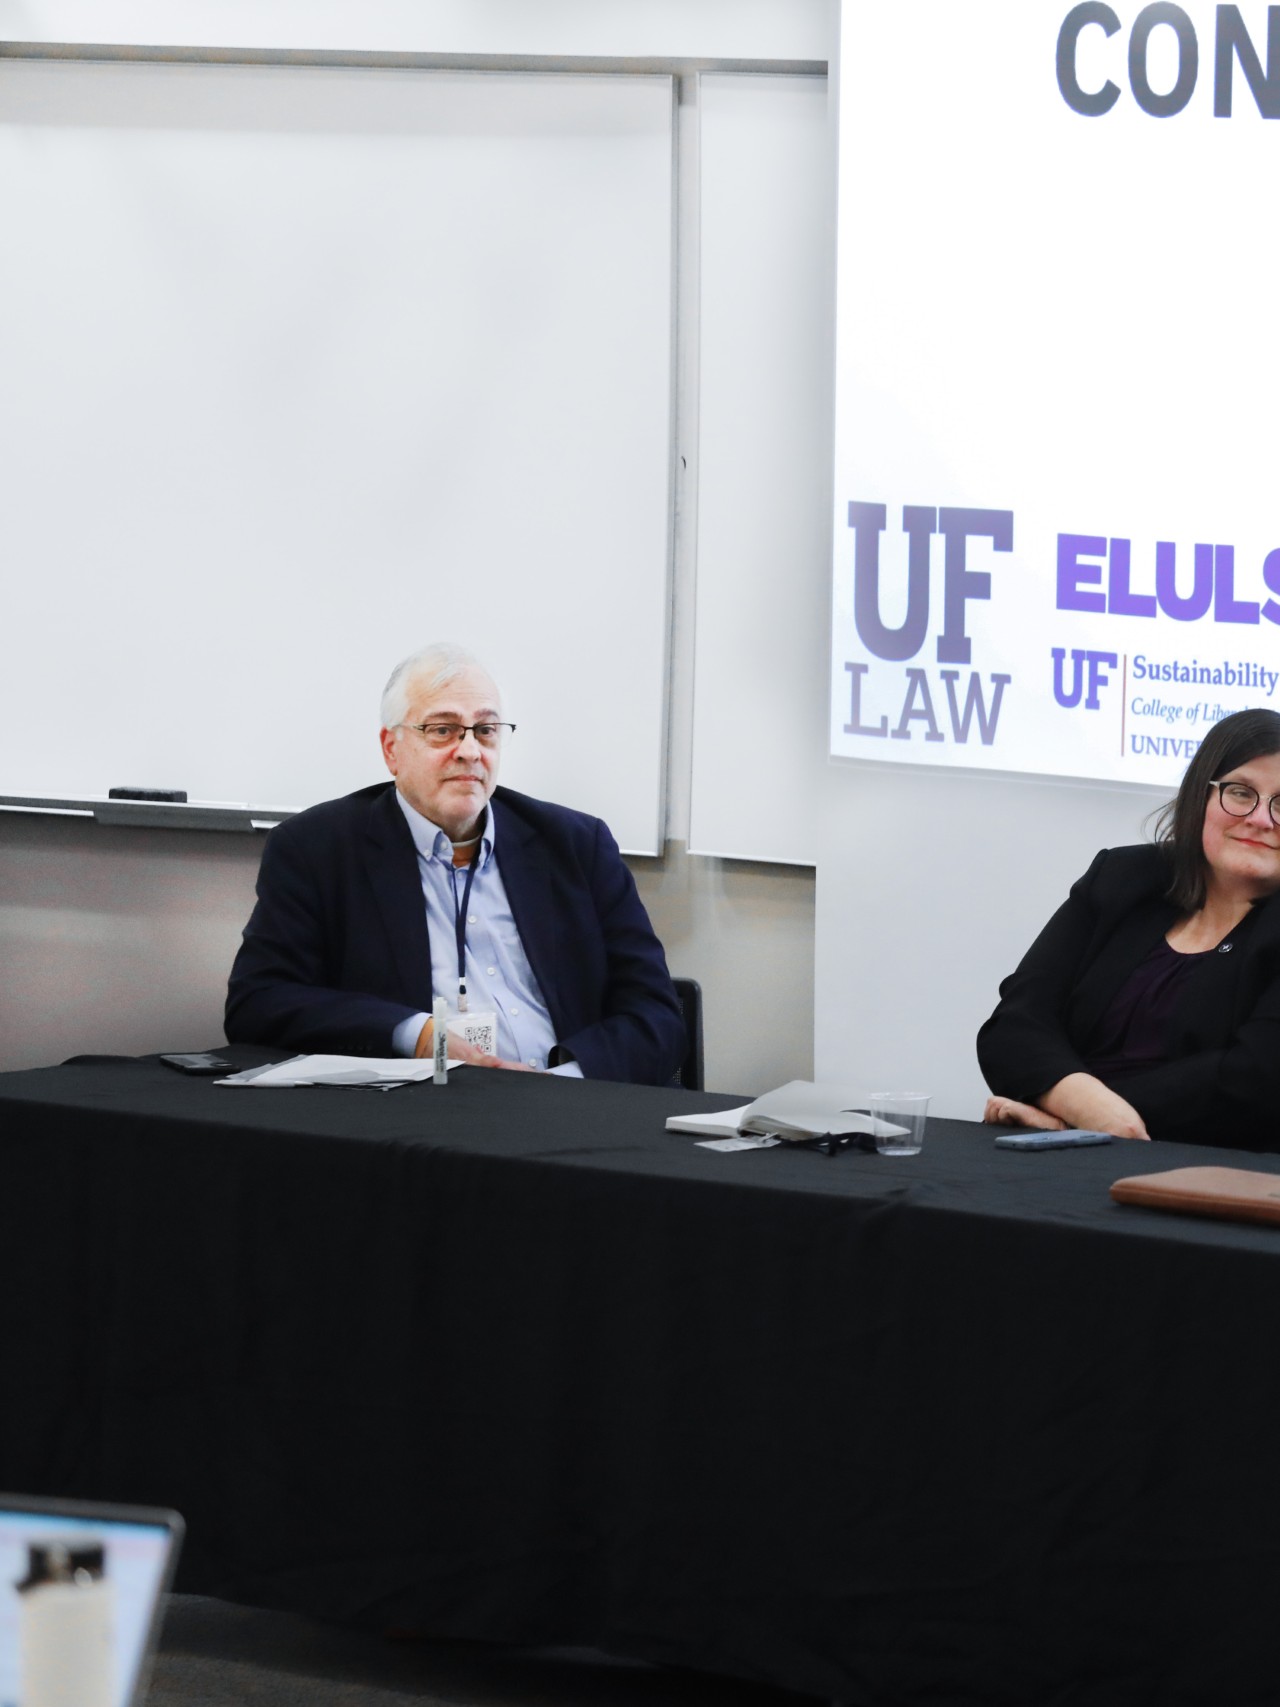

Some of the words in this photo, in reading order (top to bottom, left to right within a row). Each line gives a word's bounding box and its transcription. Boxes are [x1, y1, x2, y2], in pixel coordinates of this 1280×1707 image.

[846, 501, 1014, 664] UF
[843, 661, 1012, 746] LAW
[1051, 647, 1118, 711] UF
[1132, 655, 1279, 697] Sustainability
[1131, 697, 1183, 724] College
[1186, 702, 1201, 726] of
